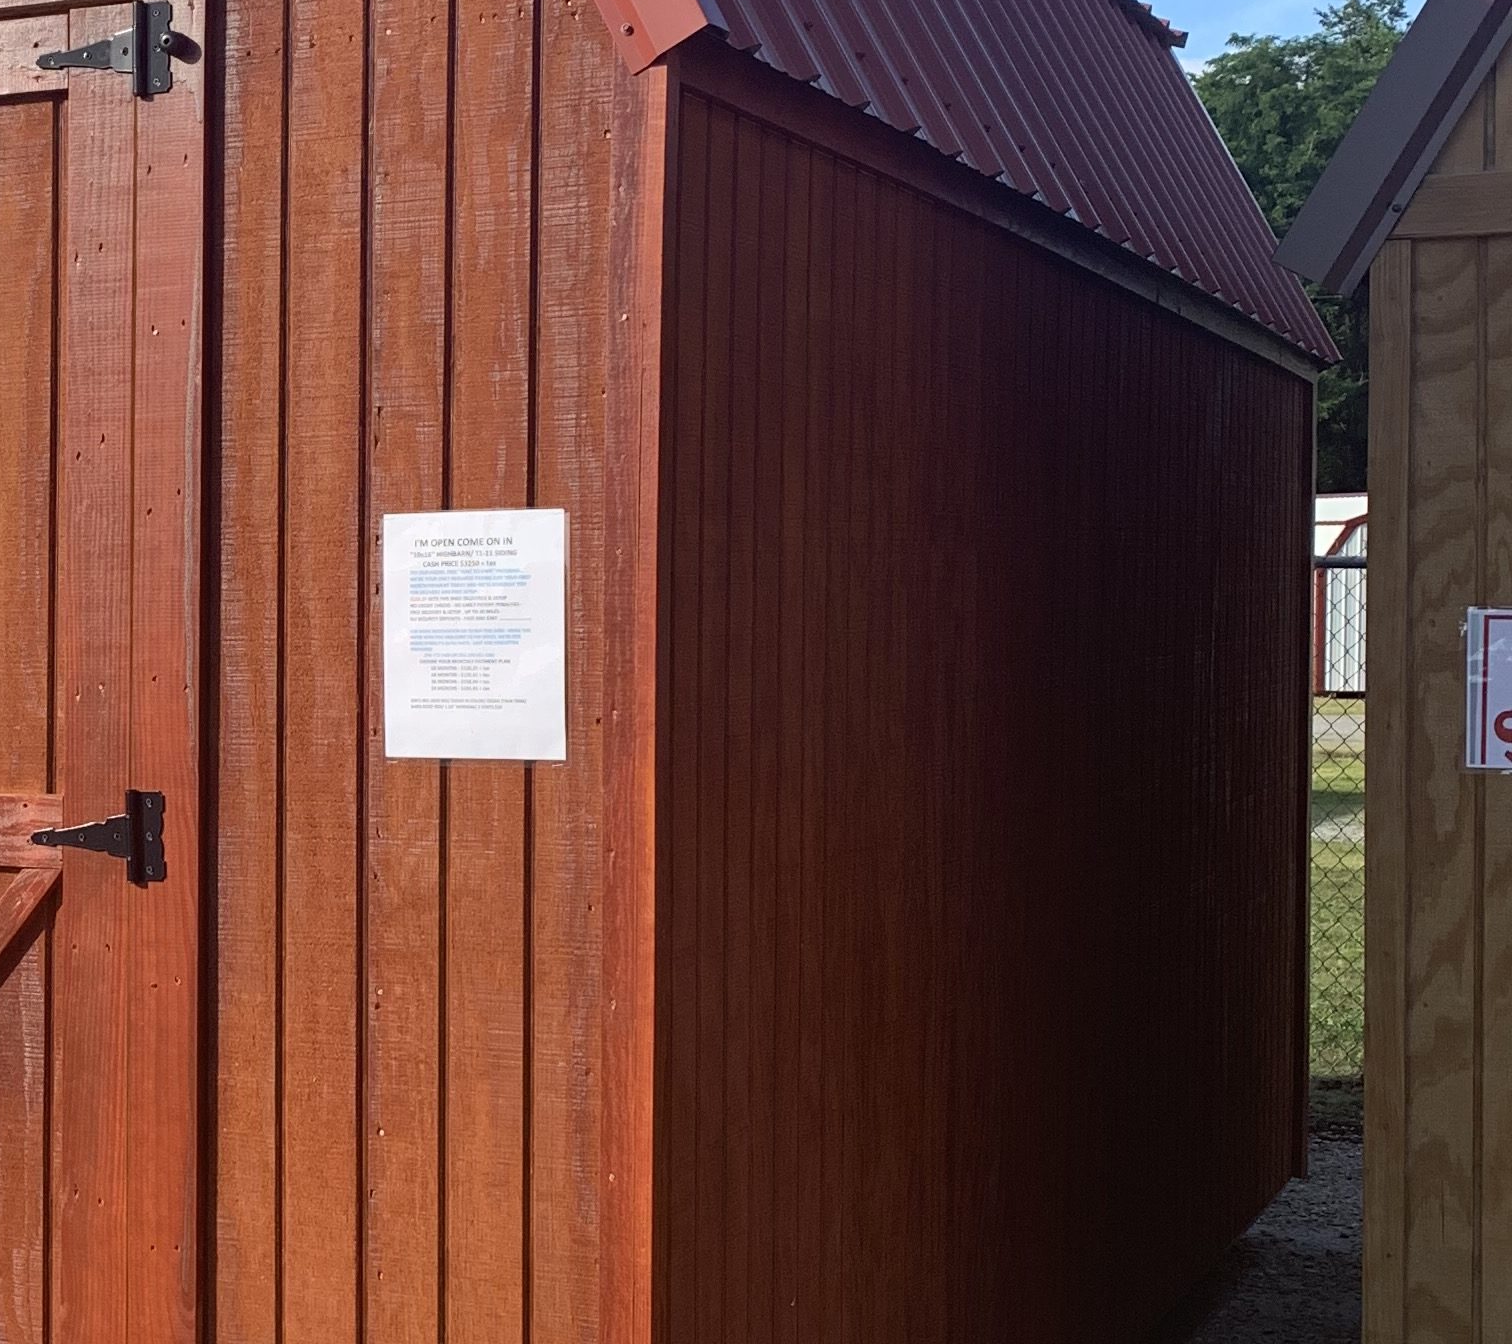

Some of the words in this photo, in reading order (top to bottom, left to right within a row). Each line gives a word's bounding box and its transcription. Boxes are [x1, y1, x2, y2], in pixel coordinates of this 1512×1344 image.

[414, 539, 428, 547] I'M
[431, 538, 455, 547] OPEN
[457, 537, 484, 546] COME
[486, 537, 500, 546] ON
[503, 536, 513, 545] IN
[422, 560, 439, 568] CASH
